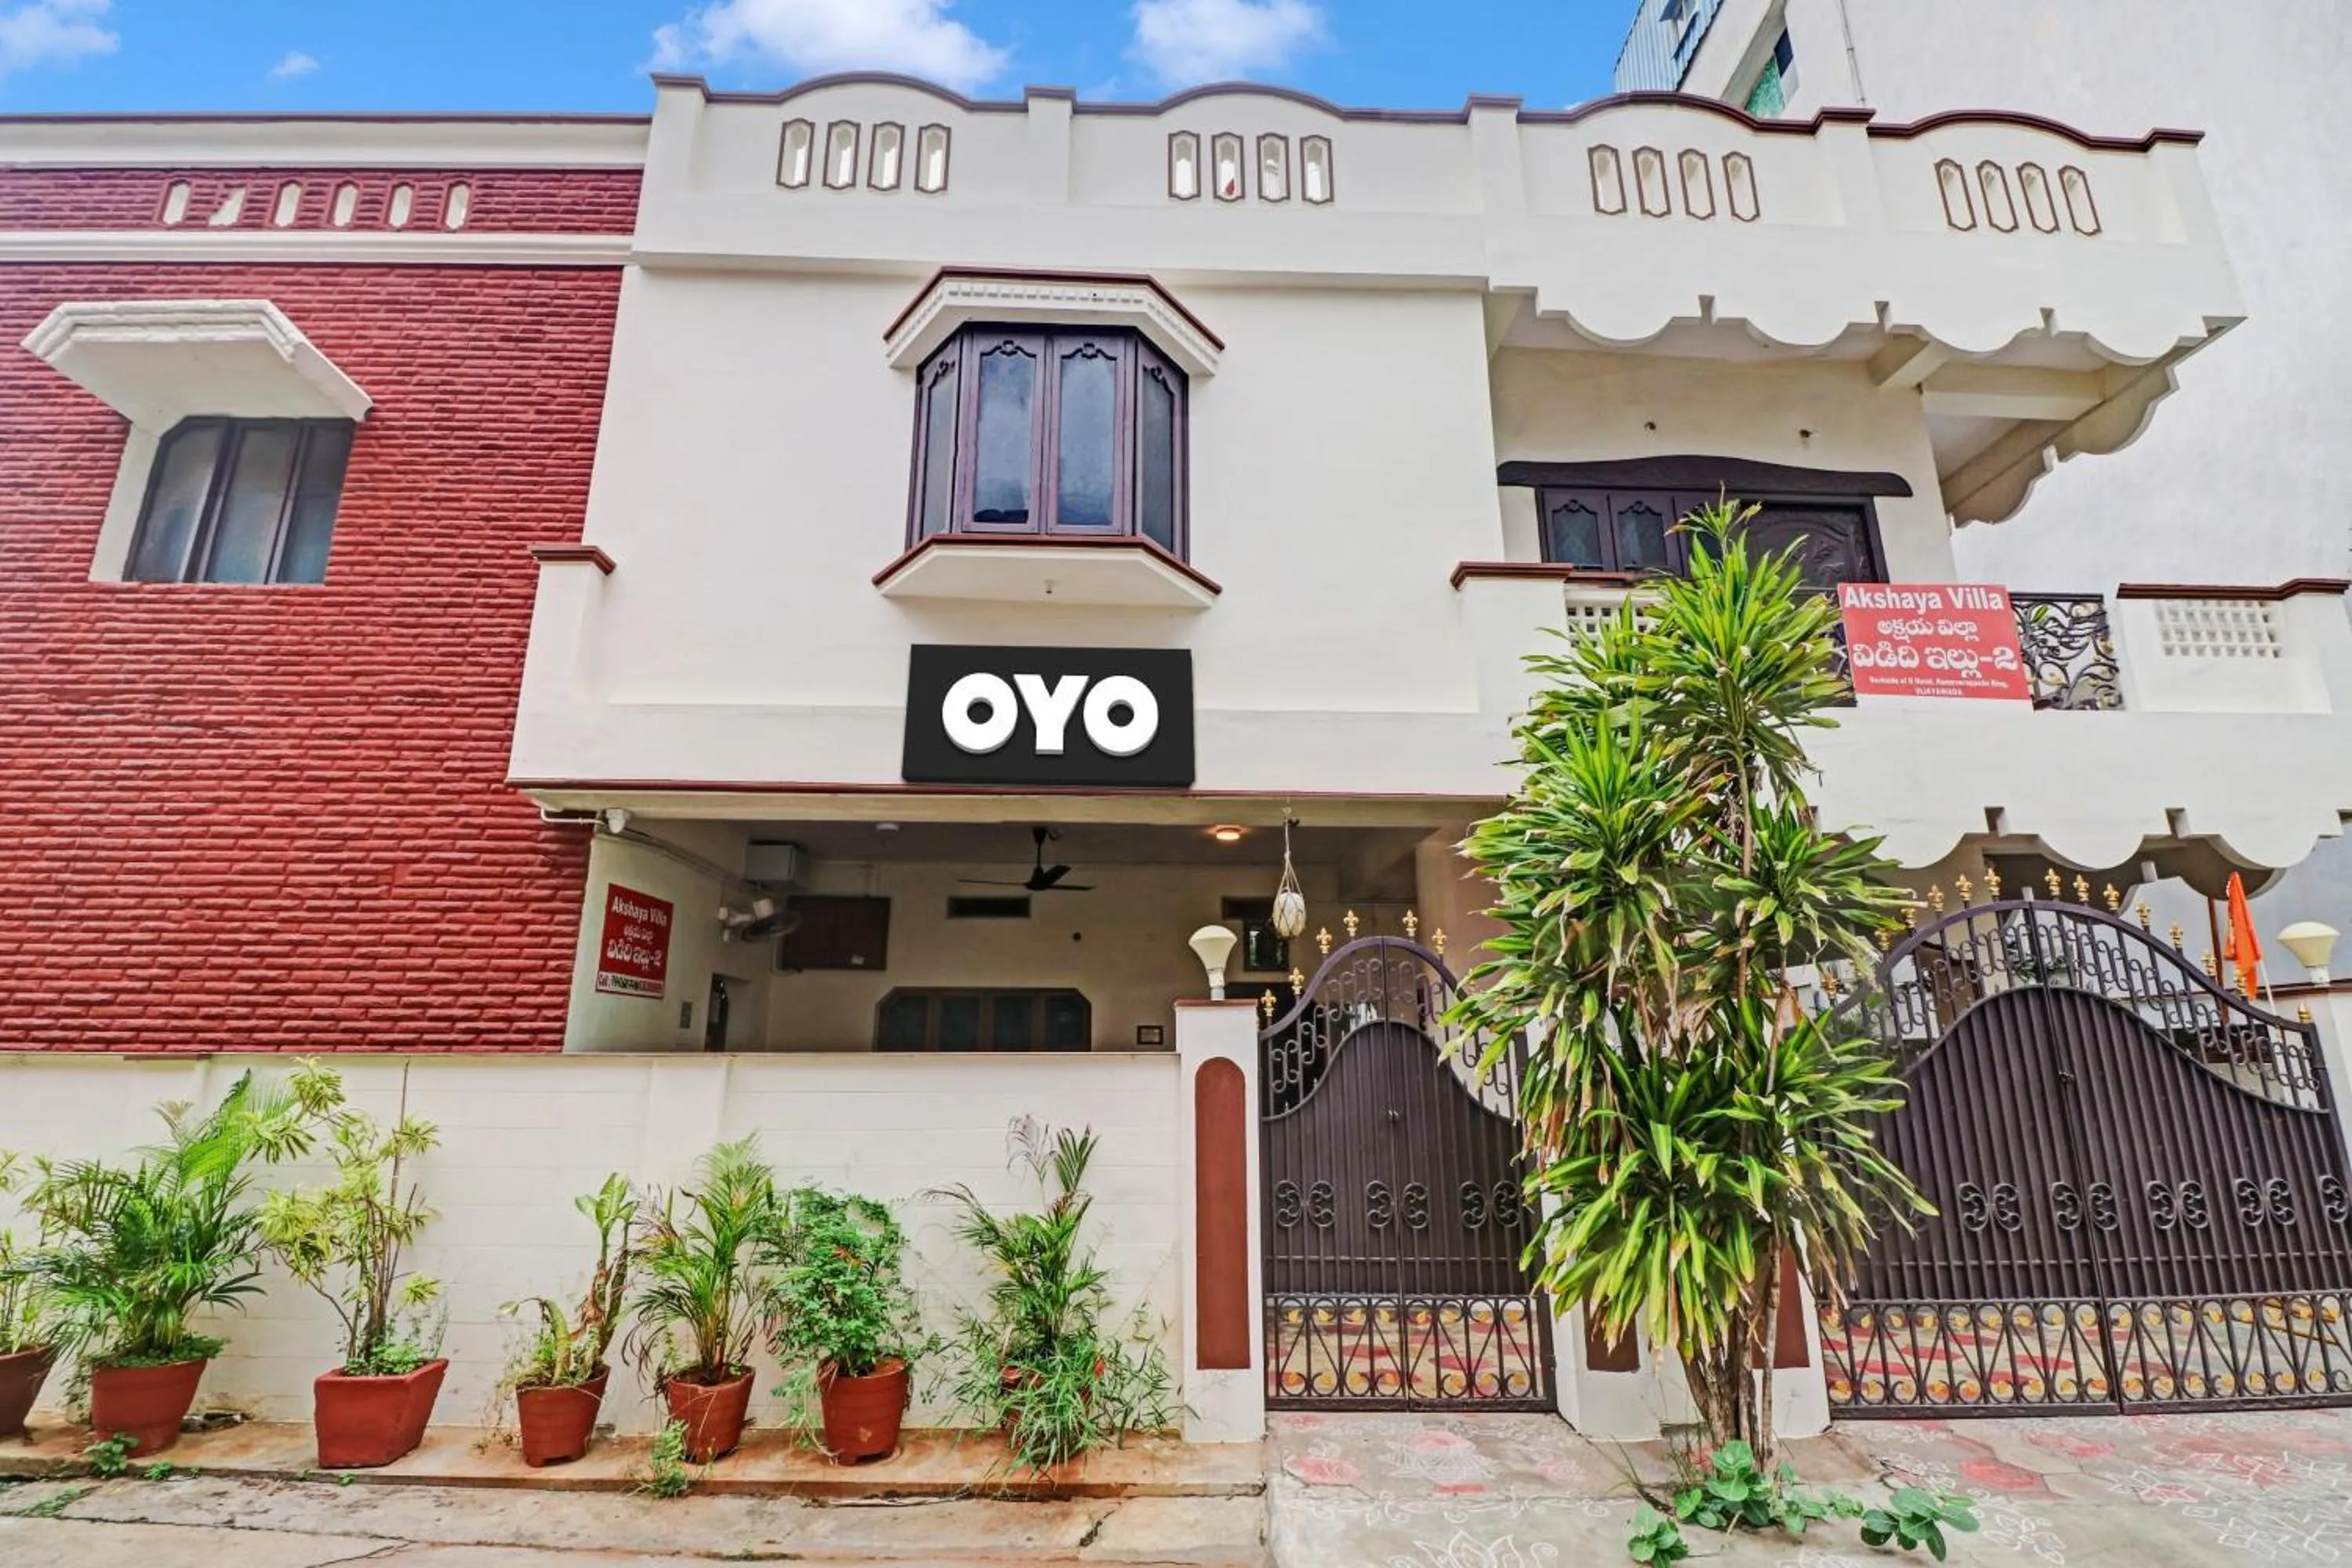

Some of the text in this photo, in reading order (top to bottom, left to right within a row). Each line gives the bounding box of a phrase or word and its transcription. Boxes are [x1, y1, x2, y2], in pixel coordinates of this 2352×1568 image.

[1845, 586, 2004, 615] Akshaya Villa
[942, 672, 1159, 757] OYO
[612, 896, 667, 927] Akshaya Villa
